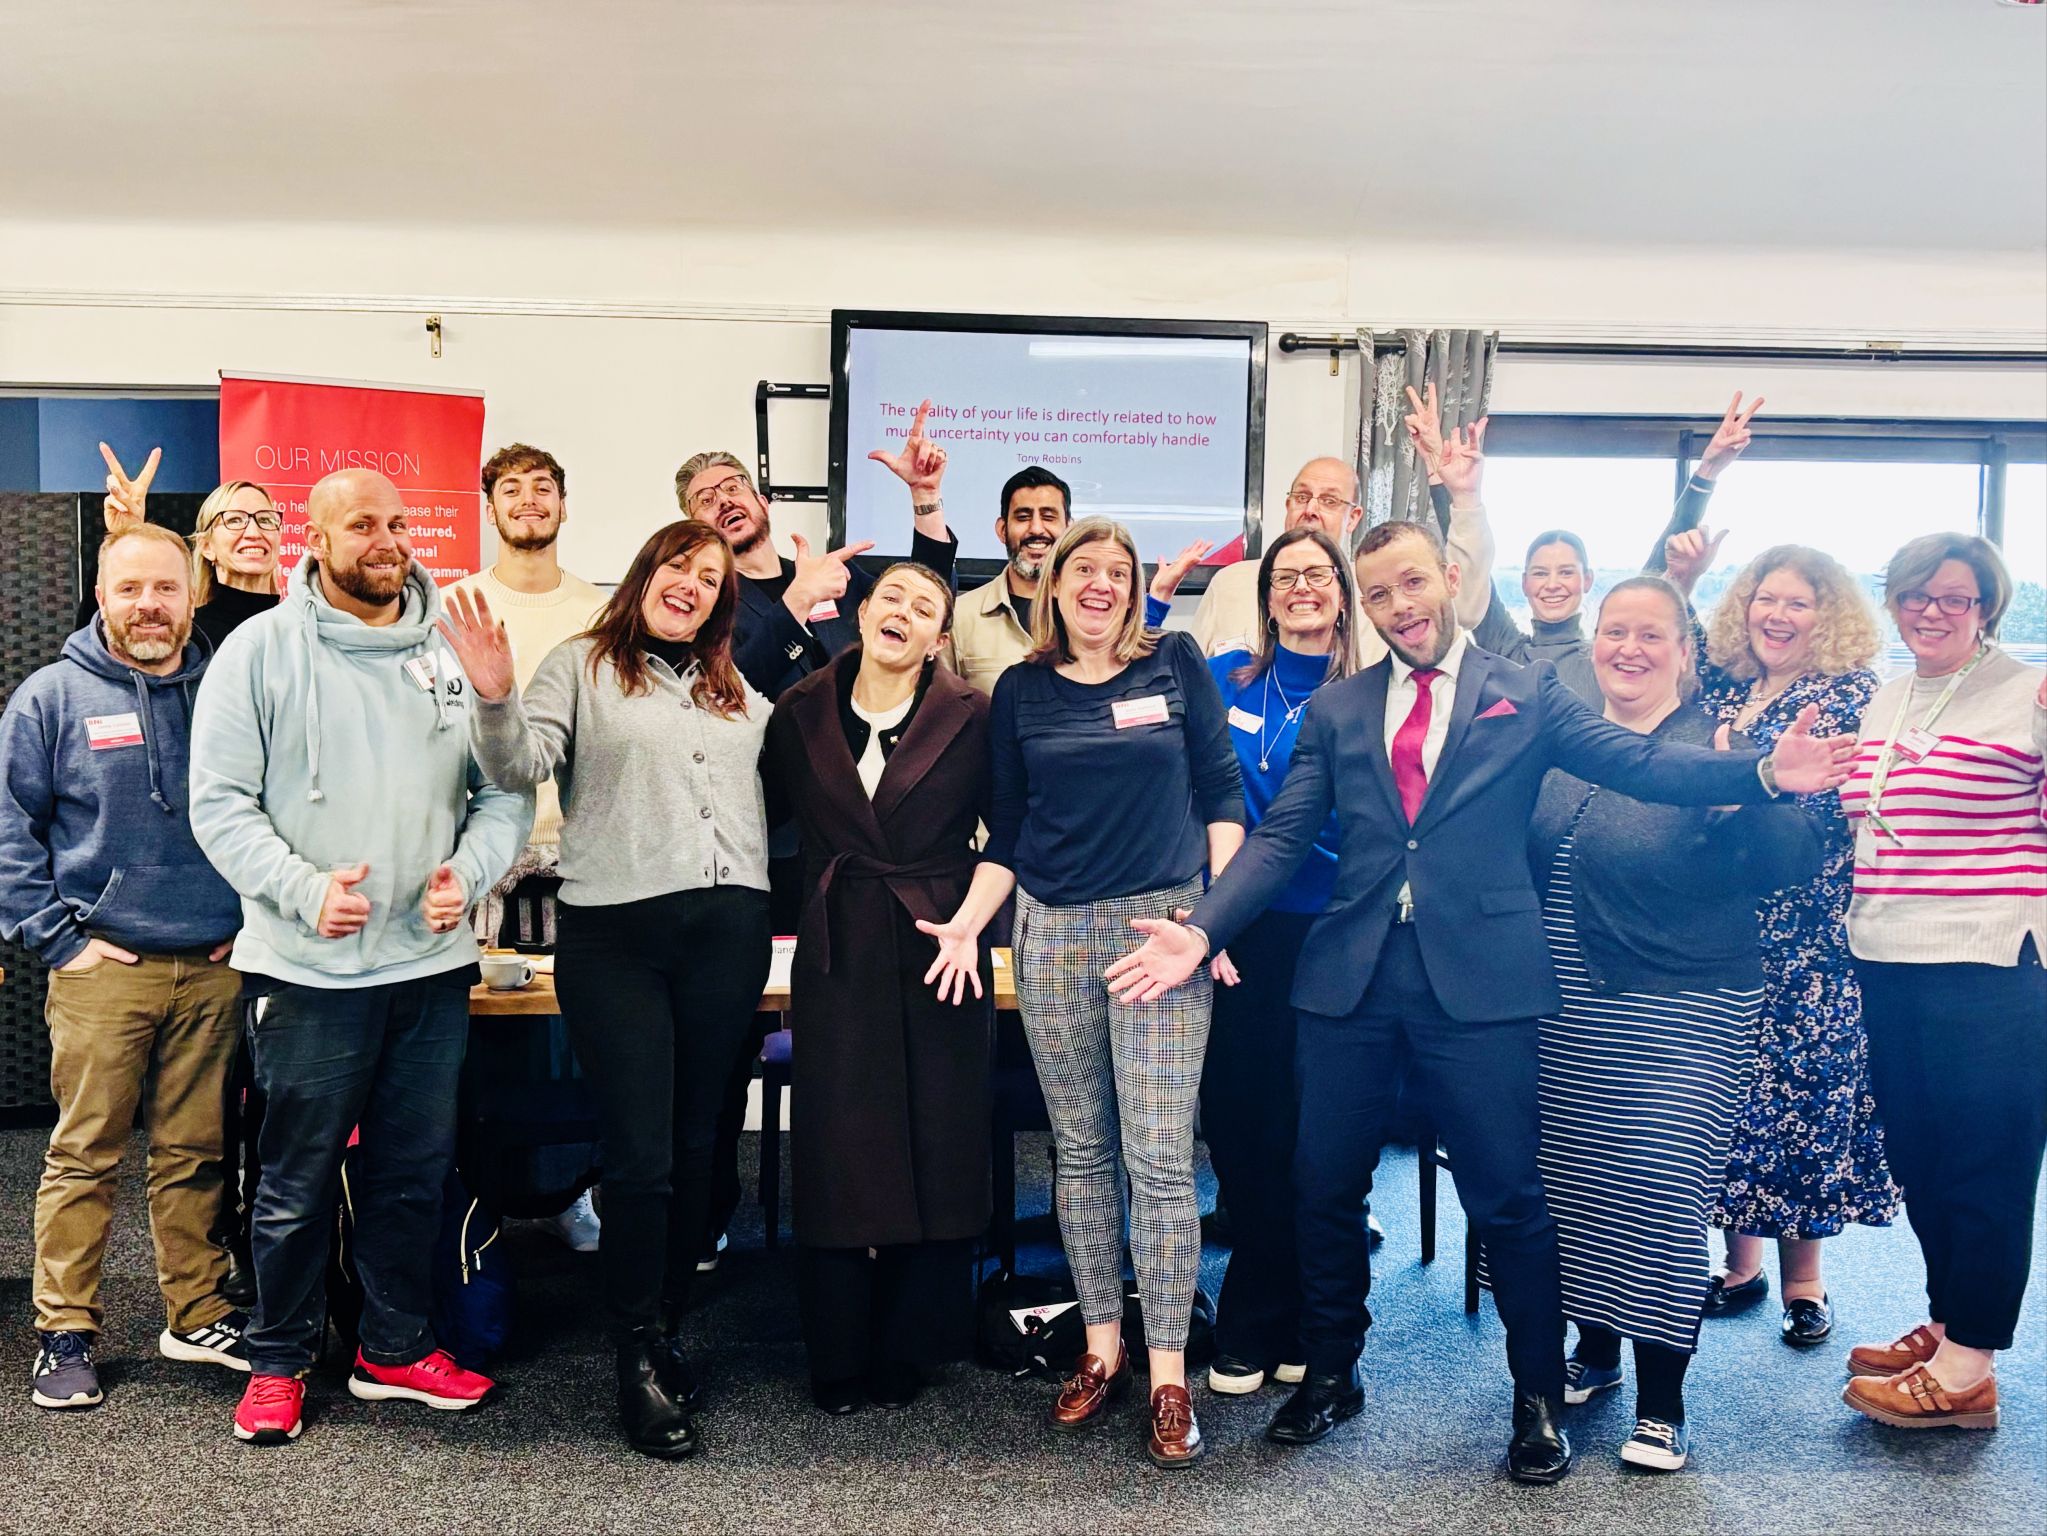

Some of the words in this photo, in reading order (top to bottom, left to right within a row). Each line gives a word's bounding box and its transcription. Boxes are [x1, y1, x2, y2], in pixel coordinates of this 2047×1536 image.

[880, 403, 906, 417] The
[910, 405, 958, 421] qality
[962, 406, 977, 419] of
[981, 409, 1013, 422] your
[1017, 407, 1038, 420] life
[1042, 408, 1053, 421] is
[1056, 408, 1110, 425] directly
[1113, 410, 1163, 424] related
[1167, 412, 1182, 425] to
[1186, 412, 1217, 425] how
[885, 426, 924, 438] muc
[929, 427, 1010, 444] uncertainty
[1013, 431, 1039, 444] you
[1043, 432, 1068, 443] can
[1072, 430, 1158, 448] comfortably
[1161, 432, 1210, 447] handle
[255, 445, 310, 471] OUR
[320, 449, 420, 476] MISSION
[1016, 453, 1040, 465] Tony
[1042, 454, 1082, 464] Robbins
[272, 500, 286, 512] to
[290, 500, 308, 514] hel
[402, 506, 431, 517] ease
[434, 505, 459, 517] their
[408, 525, 456, 540] ctured,
